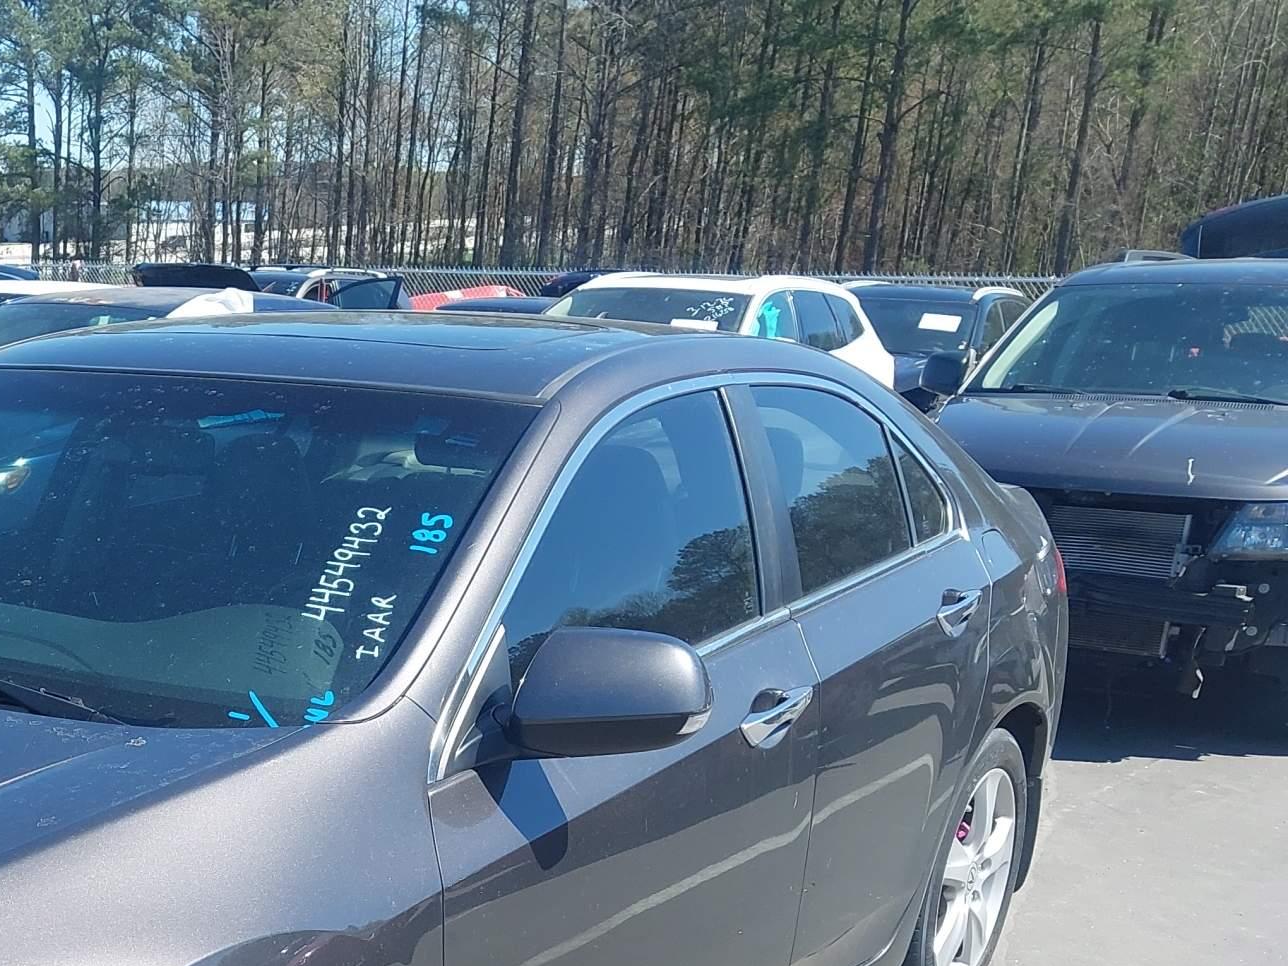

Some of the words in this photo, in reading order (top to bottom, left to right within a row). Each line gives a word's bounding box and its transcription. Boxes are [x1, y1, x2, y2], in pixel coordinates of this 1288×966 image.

[301, 506, 393, 621] 44549432
[409, 512, 454, 554] 185
[355, 594, 398, 660] IAAR
